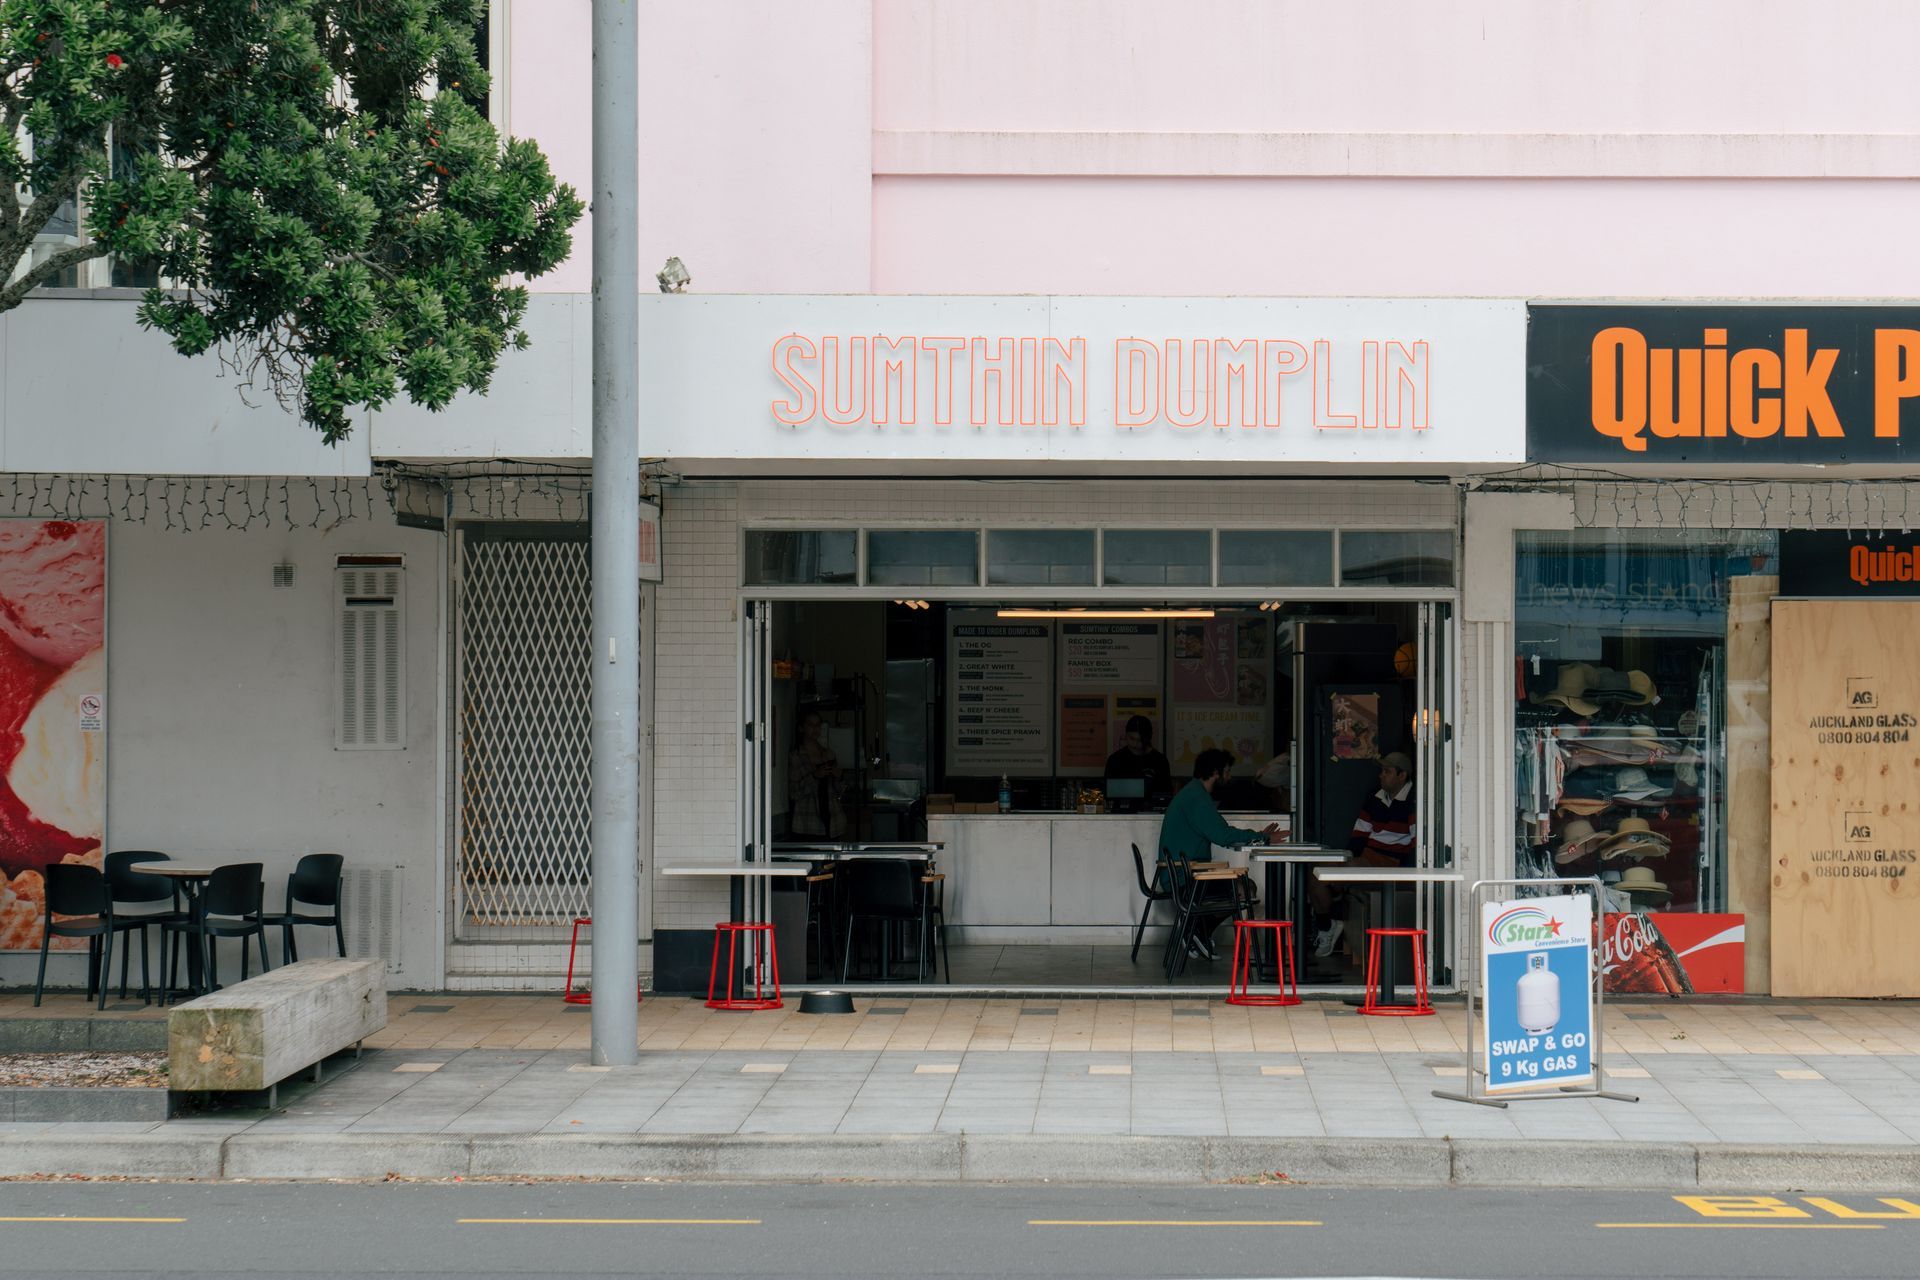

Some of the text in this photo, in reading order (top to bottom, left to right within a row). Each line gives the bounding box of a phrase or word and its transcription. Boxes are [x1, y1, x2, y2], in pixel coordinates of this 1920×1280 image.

[771, 335, 1430, 429] SUMTHIN DUMPLIN
[1591, 326, 1846, 452] Quick
[1111, 625, 1138, 633] COMBOS
[1852, 691, 1873, 705] AG
[1194, 711, 1208, 721] ICE
[1209, 711, 1238, 721] CREAM
[1239, 711, 1262, 721] TIME
[1809, 713, 1917, 728] AUCKLAND GLASS
[1818, 729, 1909, 744] 0800 804 804
[1850, 825, 1871, 838] AG
[1874, 849, 1916, 862] GLASS
[1816, 865, 1850, 878] 0800
[1853, 865, 1877, 878] 804
[1506, 923, 1553, 943] Starz
[1534, 936, 1586, 947] Convenience Store
[1492, 1032, 1586, 1056] SWAP & GO
[1501, 1054, 1577, 1077] 9 Kg GAS
